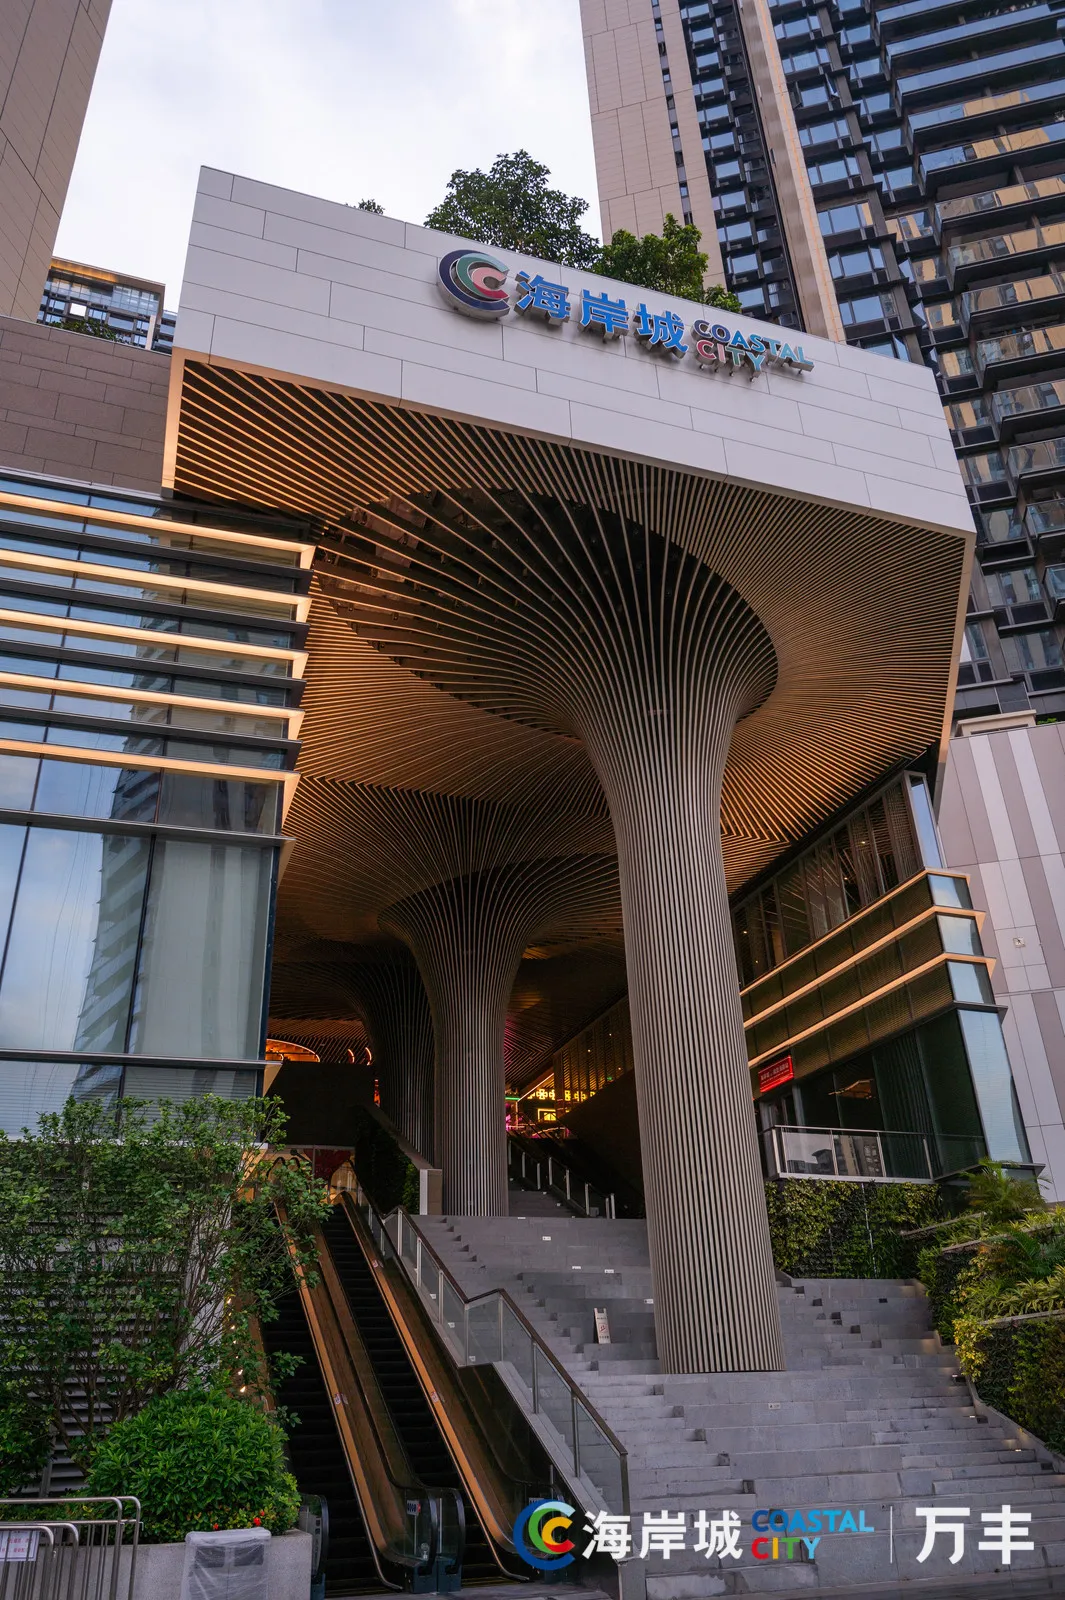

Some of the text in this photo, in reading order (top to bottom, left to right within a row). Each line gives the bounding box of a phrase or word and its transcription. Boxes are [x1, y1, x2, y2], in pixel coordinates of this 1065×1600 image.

[516, 269, 690, 355] 海岸城
[693, 319, 814, 366] COASTAL
[696, 339, 766, 372] CITY
